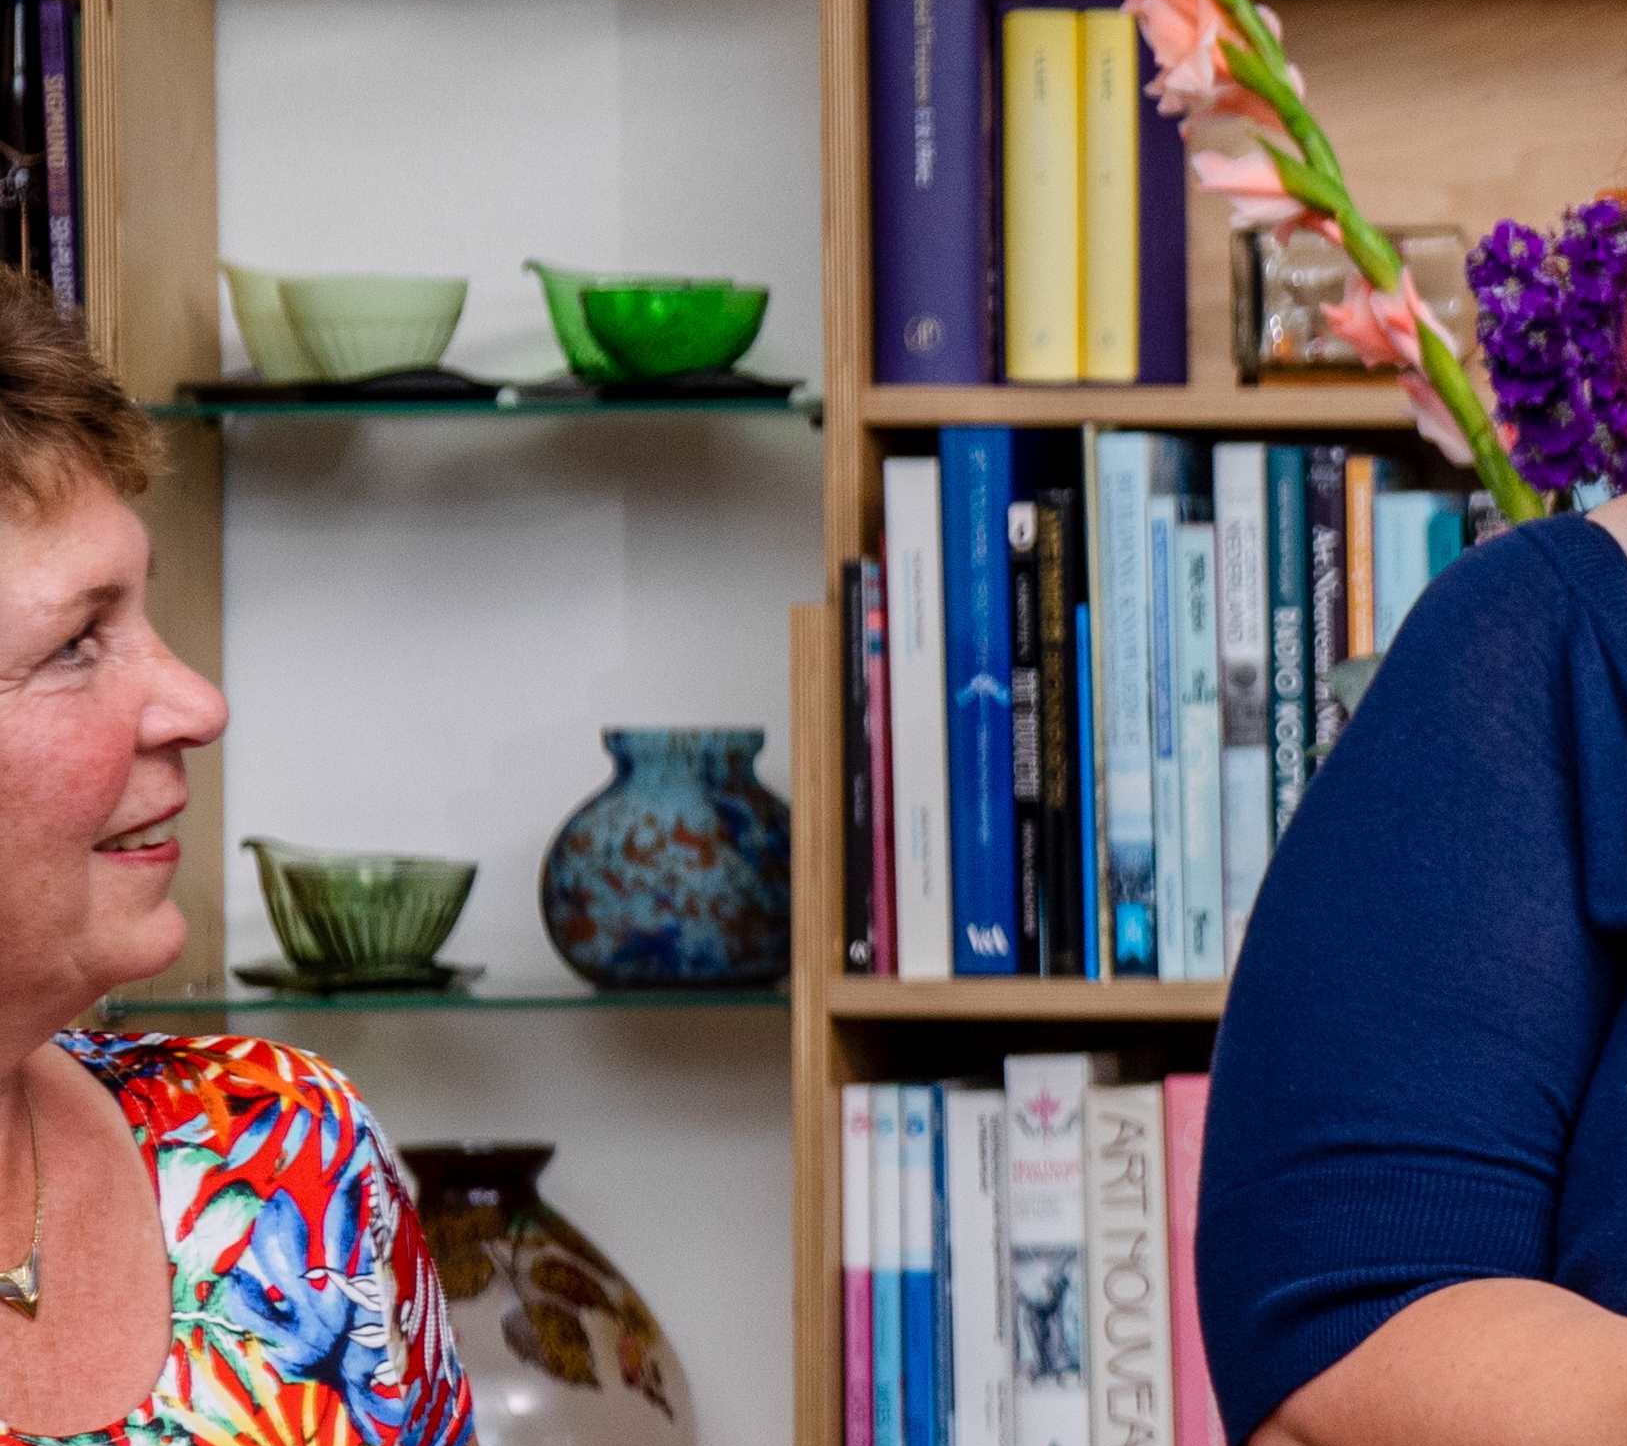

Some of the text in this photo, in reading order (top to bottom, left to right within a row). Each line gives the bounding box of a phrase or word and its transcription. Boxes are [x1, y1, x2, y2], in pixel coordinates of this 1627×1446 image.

[1311, 524, 1338, 567] Art
[1272, 606, 1301, 695] RADIO
[1102, 1111, 1150, 1217] ART
